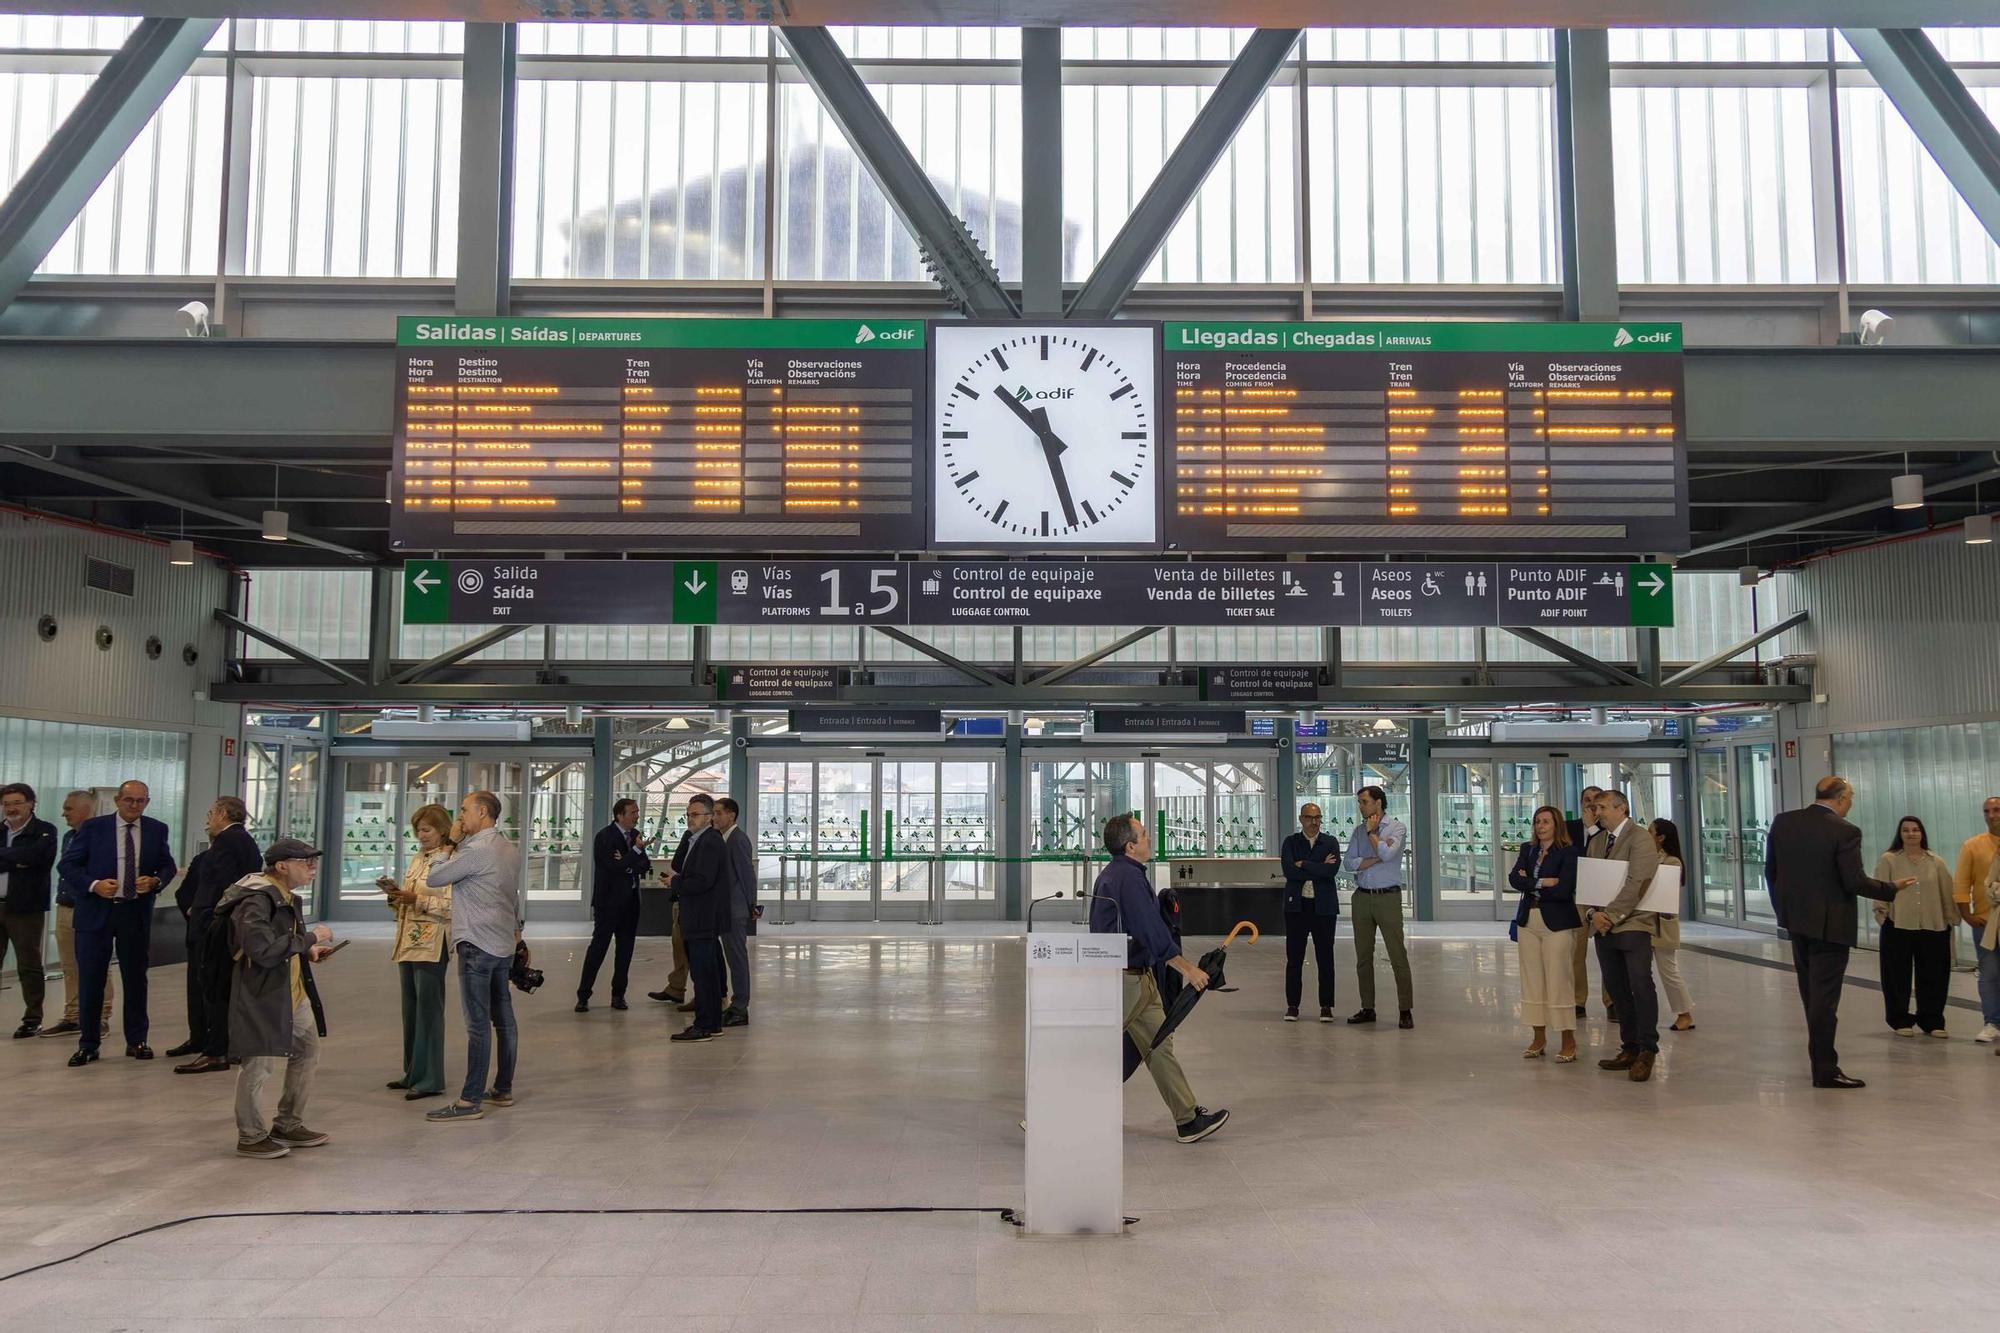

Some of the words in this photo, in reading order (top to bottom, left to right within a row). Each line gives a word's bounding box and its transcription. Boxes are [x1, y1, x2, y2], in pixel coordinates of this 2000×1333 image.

[415, 323, 497, 340] Salidas
[510, 326, 568, 341] Saídas
[578, 332, 641, 341] DEPARTURES
[879, 329, 915, 340] adif
[1182, 328, 1278, 346] Llegadas
[1292, 331, 1375, 349] Chegadas
[1386, 336, 1432, 346] ARRIVALS
[1637, 332, 1672, 343] adif
[408, 358, 434, 366] Hora
[458, 357, 498, 366] Destino
[626, 359, 650, 368] Tren
[747, 359, 764, 369] Vía
[788, 359, 862, 369] Observaciones
[1176, 362, 1201, 370] Hora
[1225, 362, 1287, 371] Procedencia
[408, 368, 433, 376] Hora
[458, 367, 498, 376] Destino
[1389, 363, 1413, 371] Tren
[1508, 362, 1524, 372] Vía
[1548, 363, 1622, 372] Observaciones
[626, 368, 650, 377] Tren
[747, 368, 764, 378] Vía
[788, 368, 856, 378] Observacións
[1176, 372, 1201, 380] Hora
[1225, 372, 1287, 380] Procedencia
[1389, 372, 1413, 381] Tren
[1508, 372, 1525, 381] Vía
[1548, 372, 1616, 382] Observacións
[1036, 387, 1075, 400] adif
[493, 566, 538, 580] Salida
[763, 567, 791, 581] Vías
[953, 567, 1003, 581] Control
[1009, 567, 1026, 581] de
[1031, 567, 1095, 585] equipaje
[1154, 568, 1195, 582] Venta
[1200, 568, 1218, 582] de
[1223, 568, 1275, 582] billetes
[1372, 569, 1412, 582] Aseos
[1510, 569, 1552, 582] Punto
[1556, 569, 1587, 582] ADIF
[493, 586, 534, 599] Saída
[763, 586, 793, 600] Vías
[820, 568, 850, 616] 1
[855, 602, 865, 616] a
[870, 569, 899, 616] 5
[952, 586, 1006, 601] Control
[1010, 587, 1029, 601] de
[1034, 587, 1102, 603] equipaxe
[1147, 587, 1193, 601] Venda
[1198, 587, 1216, 601] de
[1221, 587, 1275, 601] billetes
[1371, 587, 1412, 601] Aseos
[1508, 587, 1551, 601] Punto
[1555, 587, 1587, 601] ADIF
[493, 607, 511, 615] EXIT
[762, 607, 810, 616] PLATFORMS
[952, 608, 991, 617] LUGGAGE
[993, 608, 1030, 617] CONTROL
[1225, 608, 1252, 617] TICKET
[1255, 608, 1275, 617] SALE
[1380, 608, 1412, 617] TOILETS
[1540, 609, 1560, 617] ADIF
[1562, 609, 1587, 617] POINT
[749, 668, 778, 677] Control
[780, 668, 791, 677] de
[793, 668, 829, 679] equipaje
[1230, 669, 1258, 678] Control
[1261, 669, 1272, 678] de
[1274, 669, 1309, 680] equipaje
[749, 678, 779, 687] Control
[781, 678, 792, 687] de
[794, 679, 833, 688] equipaxe
[1230, 679, 1259, 688] Control
[1262, 679, 1273, 688] de
[1274, 680, 1313, 689] equipaxe
[820, 717, 849, 725] Entrada
[856, 717, 886, 725] Entrada
[1125, 717, 1155, 726] Entrada
[1161, 717, 1191, 726] Entrada
